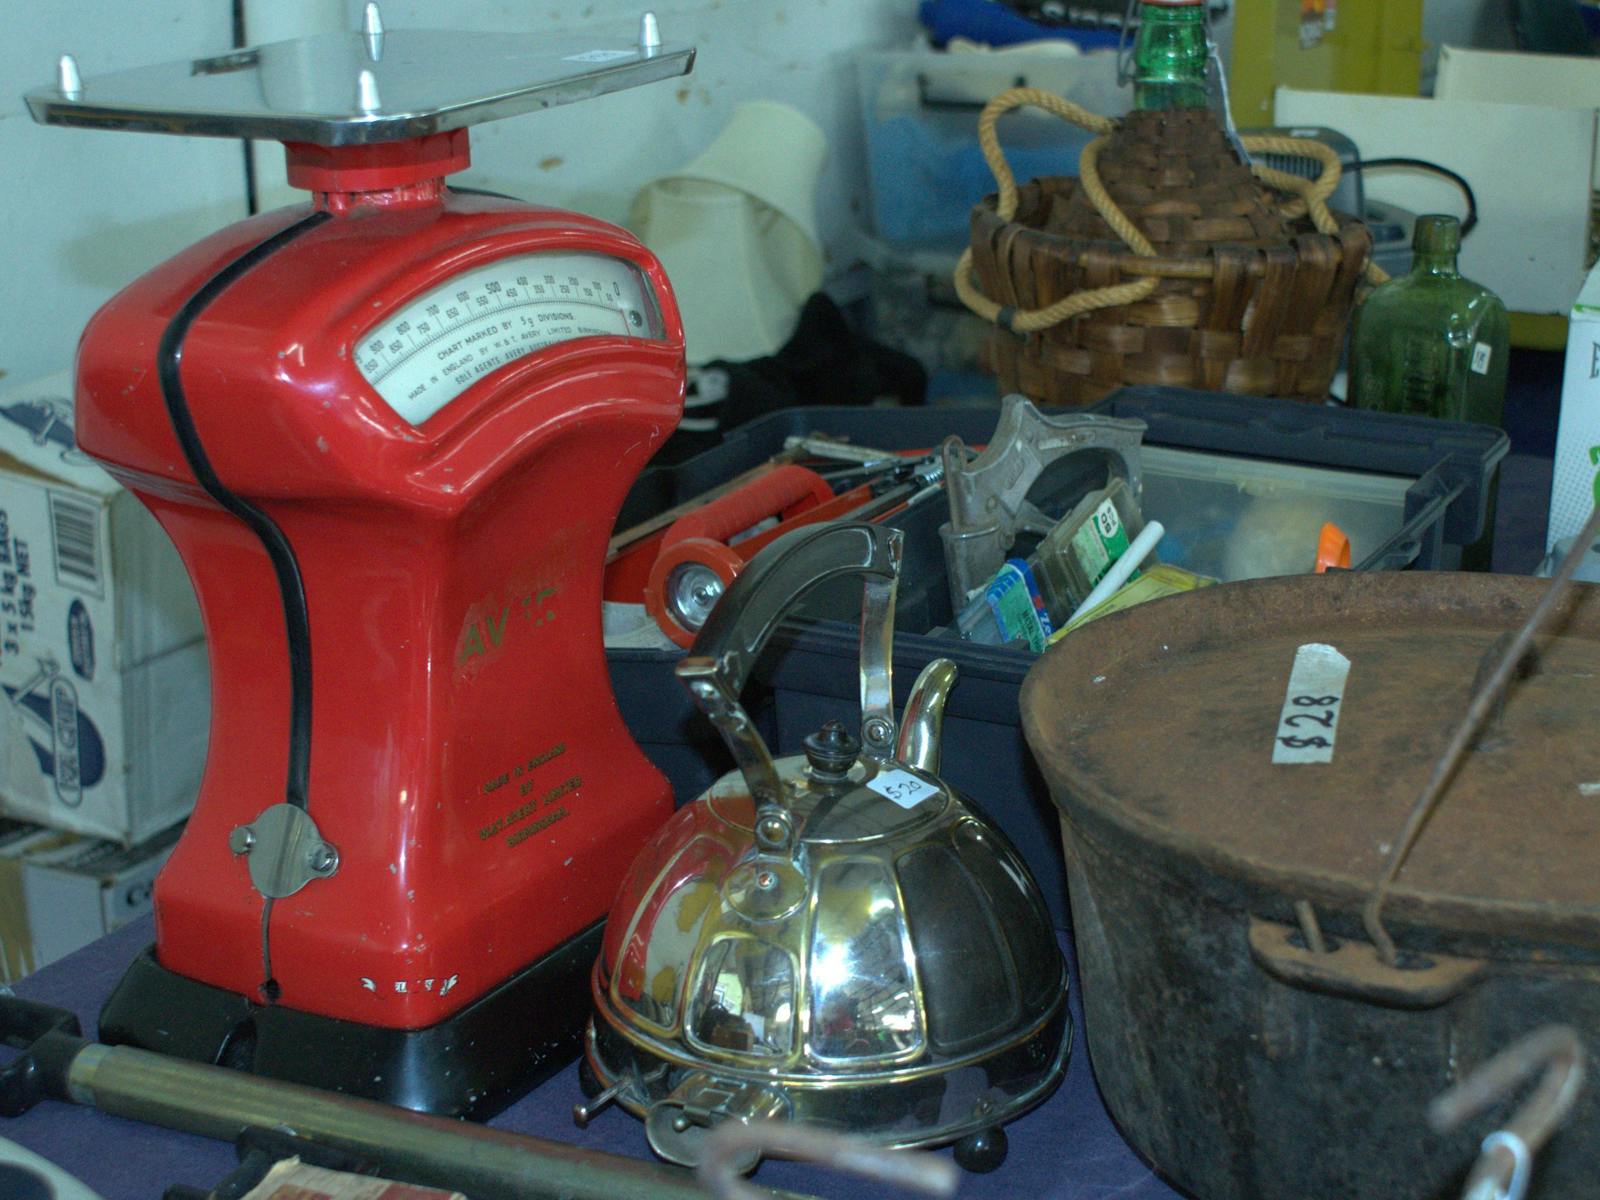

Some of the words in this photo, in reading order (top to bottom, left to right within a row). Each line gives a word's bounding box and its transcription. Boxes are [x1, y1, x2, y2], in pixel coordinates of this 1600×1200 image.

[485, 281, 502, 295] 500
[612, 281, 620, 297] 0
[437, 341, 463, 361] CHART
[464, 326, 499, 344] MARKED
[501, 319, 514, 331] BY
[408, 384, 427, 400] MADE
[442, 354, 474, 376] ENGLAND
[478, 346, 488, 356] BY
[521, 329, 541, 340] AVERY
[546, 326, 573, 336] LIMITED
[455, 371, 474, 385] SOLE
[474, 357, 501, 375] AGENTS
[504, 346, 527, 360] AVERY
[14, 536, 31, 577] NET
[1277, 695, 1339, 749] $28
